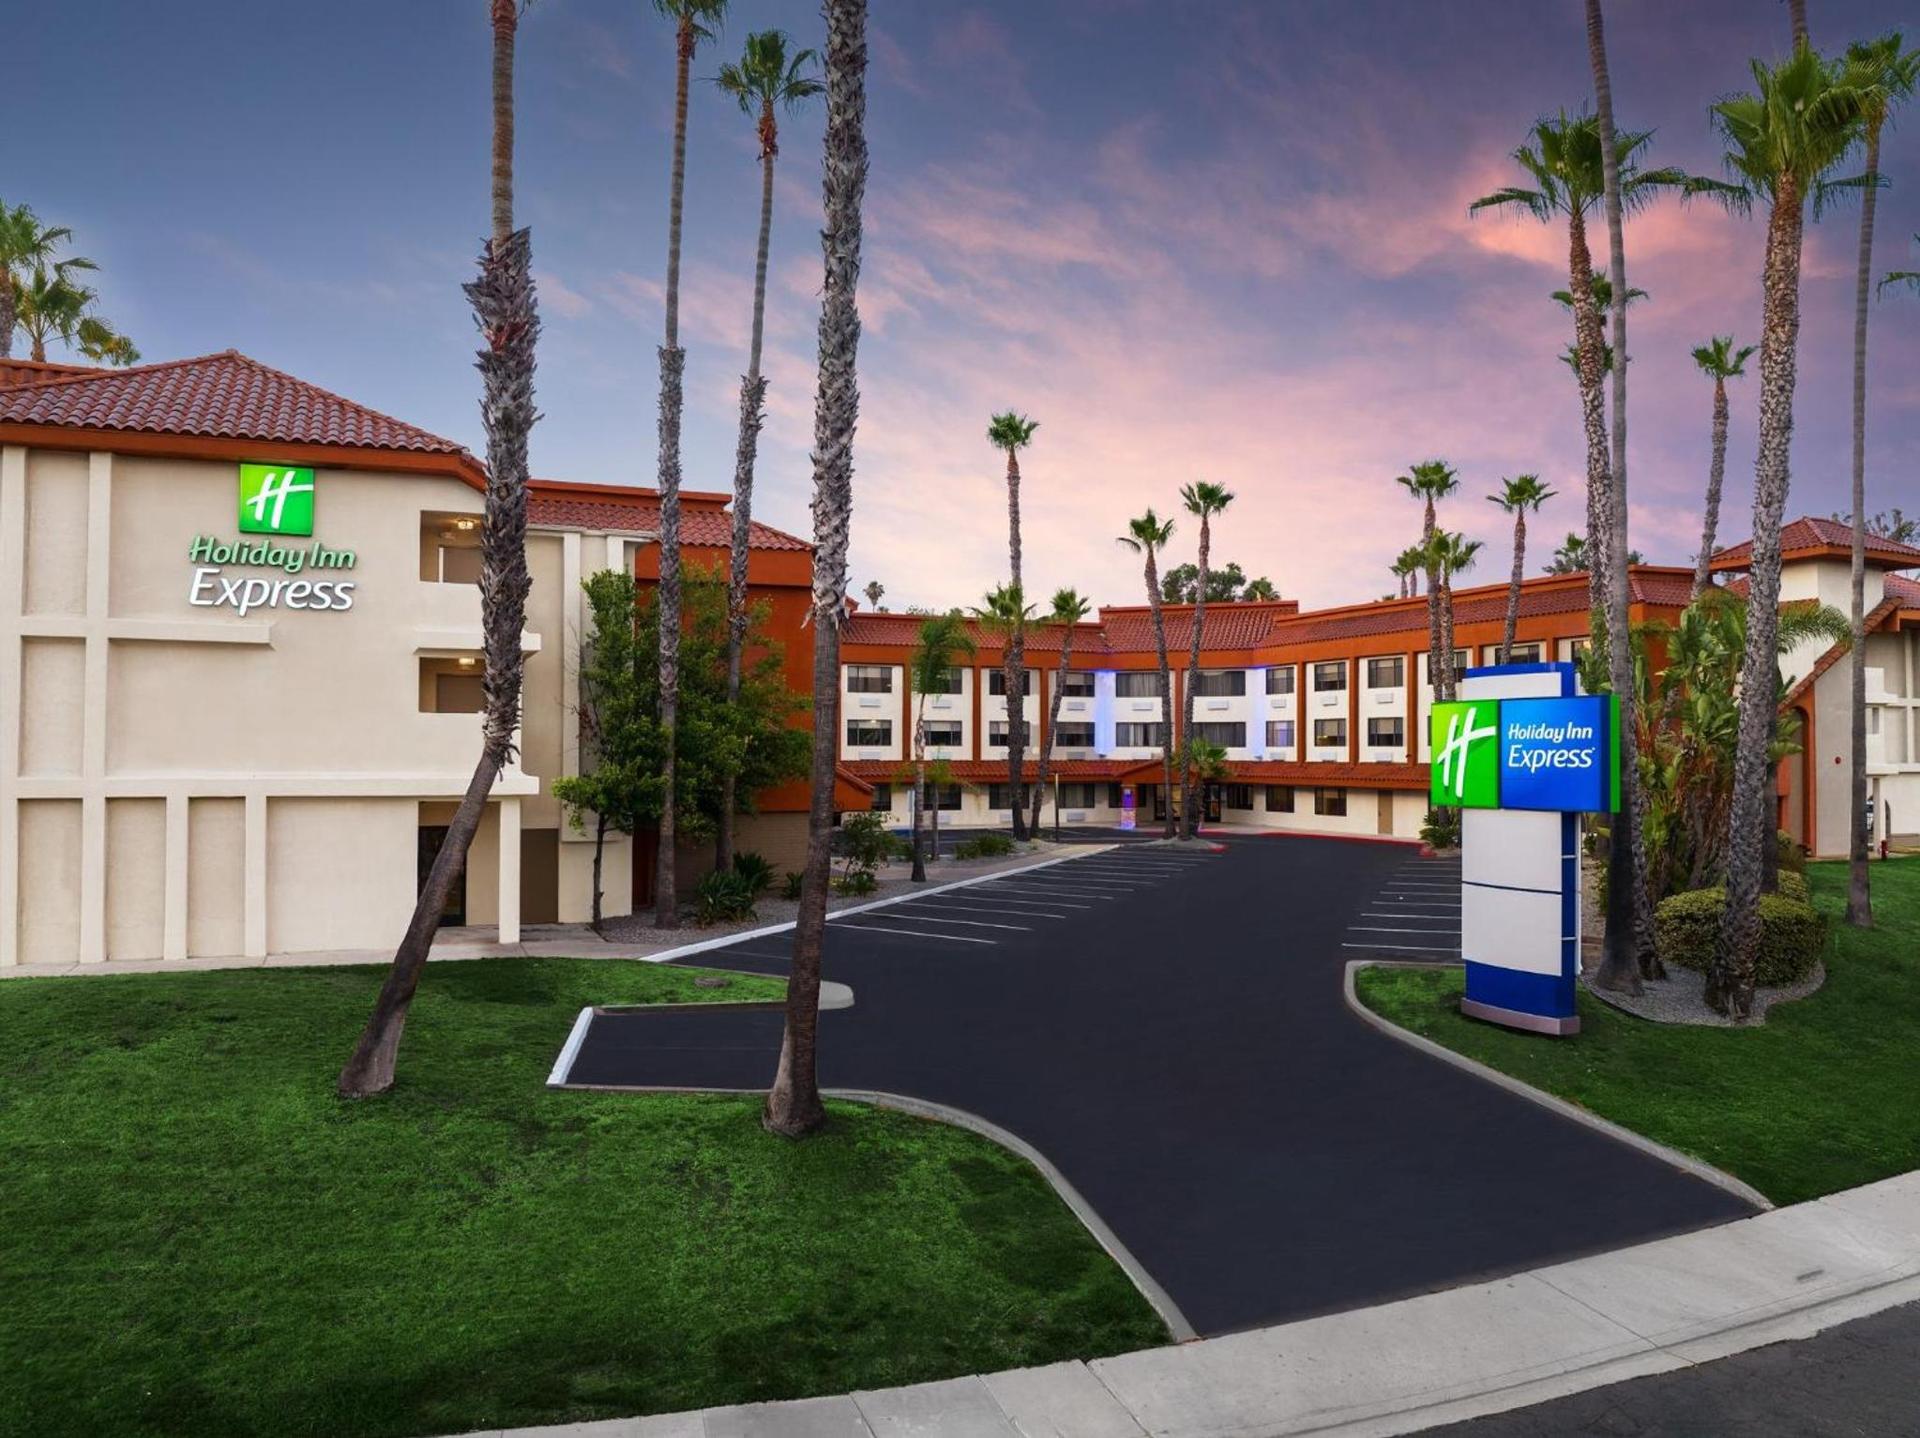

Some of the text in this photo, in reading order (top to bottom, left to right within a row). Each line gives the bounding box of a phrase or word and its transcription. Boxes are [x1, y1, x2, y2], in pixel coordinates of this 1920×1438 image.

[246, 470, 314, 529] H
[190, 535, 357, 573] Holiday Inn
[189, 567, 355, 617] Express
[1437, 707, 1496, 798] H
[1508, 722, 1593, 743] Holiday Inn
[1508, 744, 1595, 773] Express
